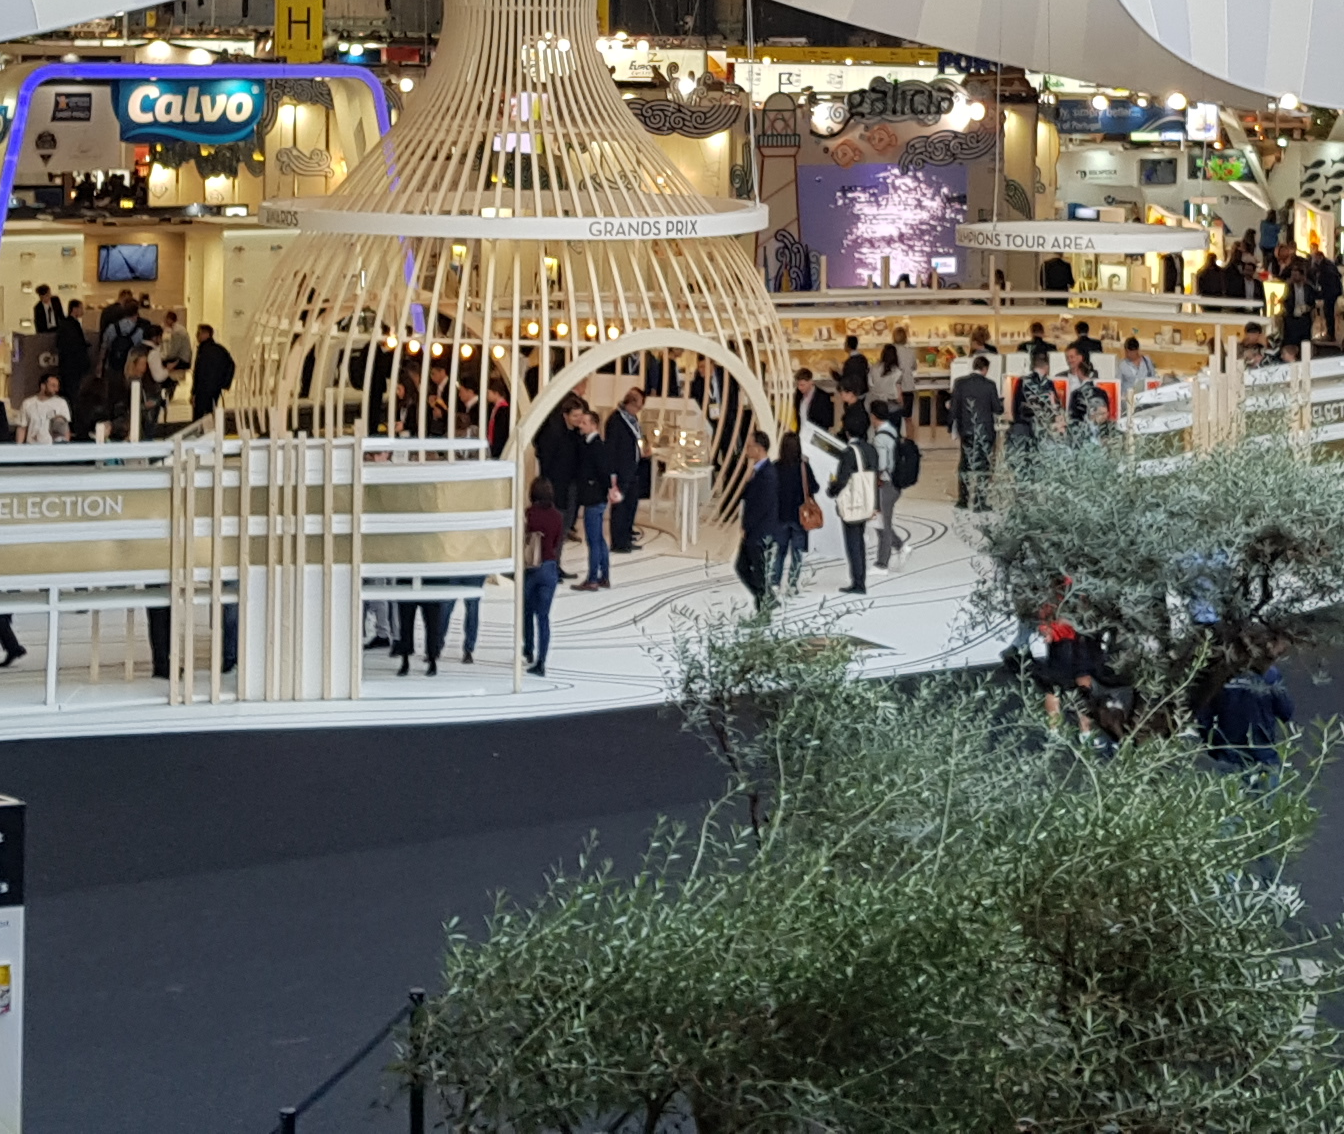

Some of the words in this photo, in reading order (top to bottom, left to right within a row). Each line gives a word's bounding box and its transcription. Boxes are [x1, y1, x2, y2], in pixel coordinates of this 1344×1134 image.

[288, 7, 311, 41] H
[128, 85, 254, 124] Calvo
[588, 220, 662, 237] GRANDS
[665, 219, 698, 236] PRIX
[1005, 234, 1047, 249] TOUR
[1050, 236, 1096, 251] AREA
